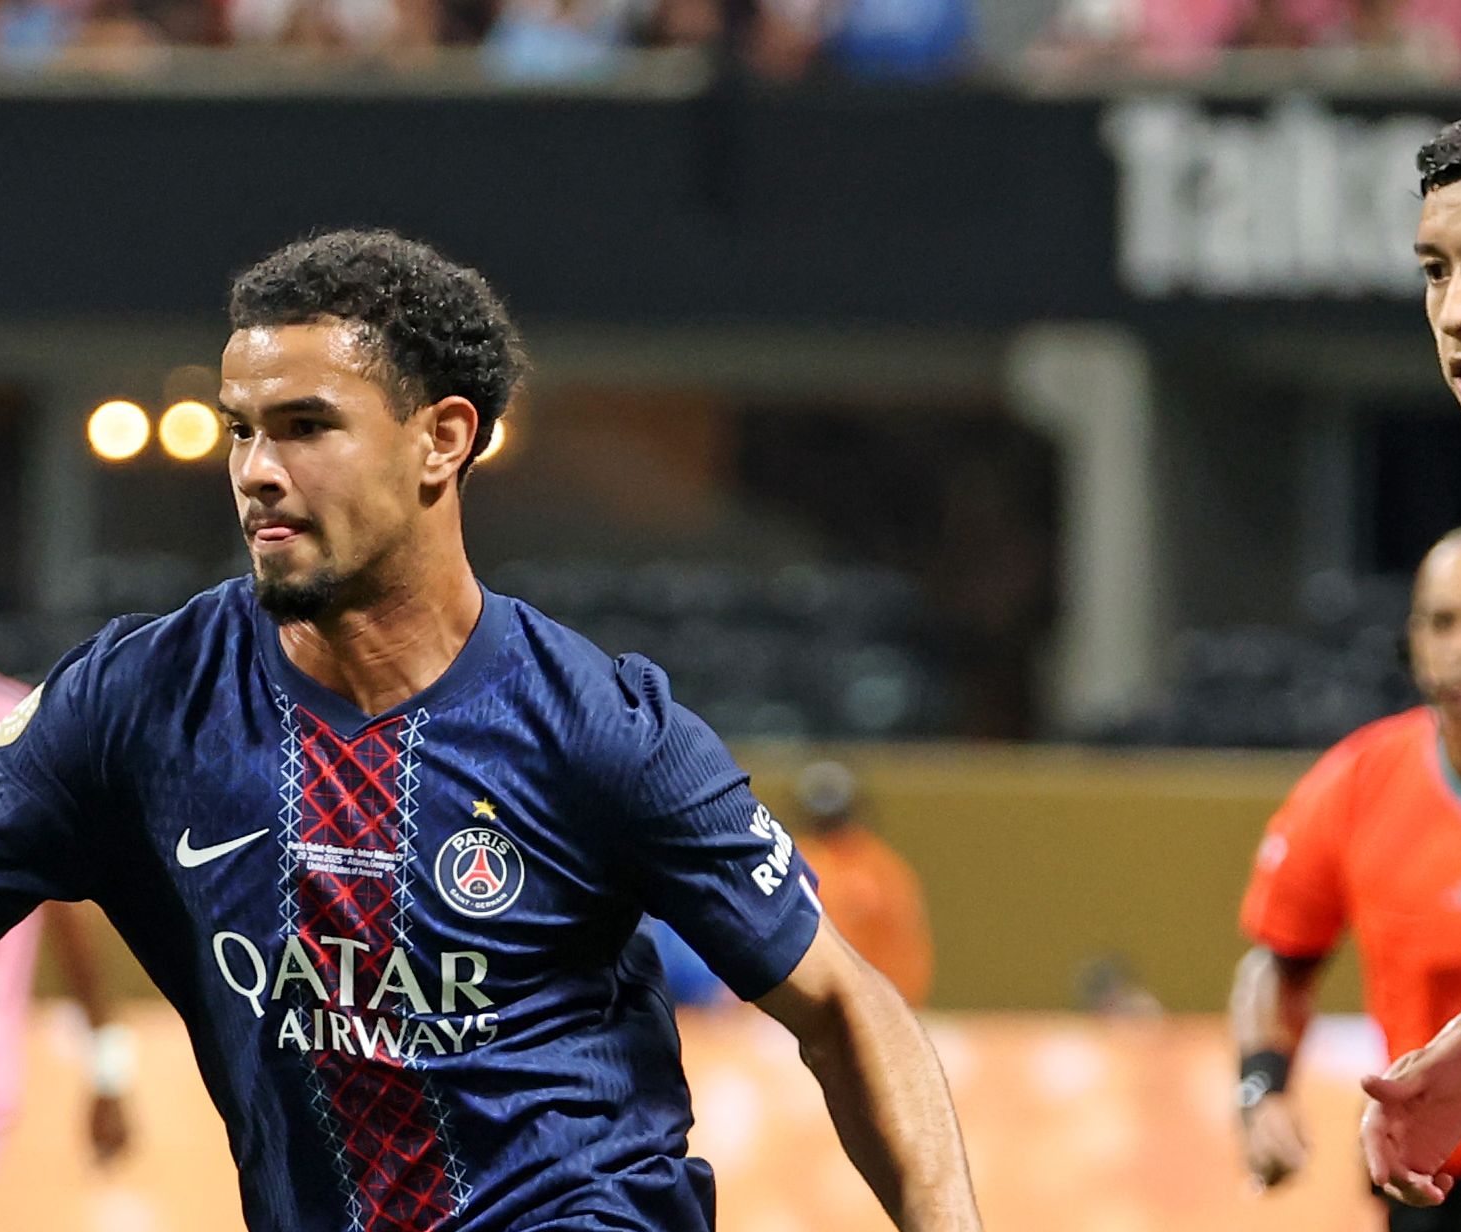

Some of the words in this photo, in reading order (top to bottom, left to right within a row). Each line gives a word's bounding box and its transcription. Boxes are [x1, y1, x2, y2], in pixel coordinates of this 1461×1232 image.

[451, 831, 510, 856] PARIS
[212, 931, 495, 1018] QATAR
[277, 1007, 499, 1059] AIRWAYS
